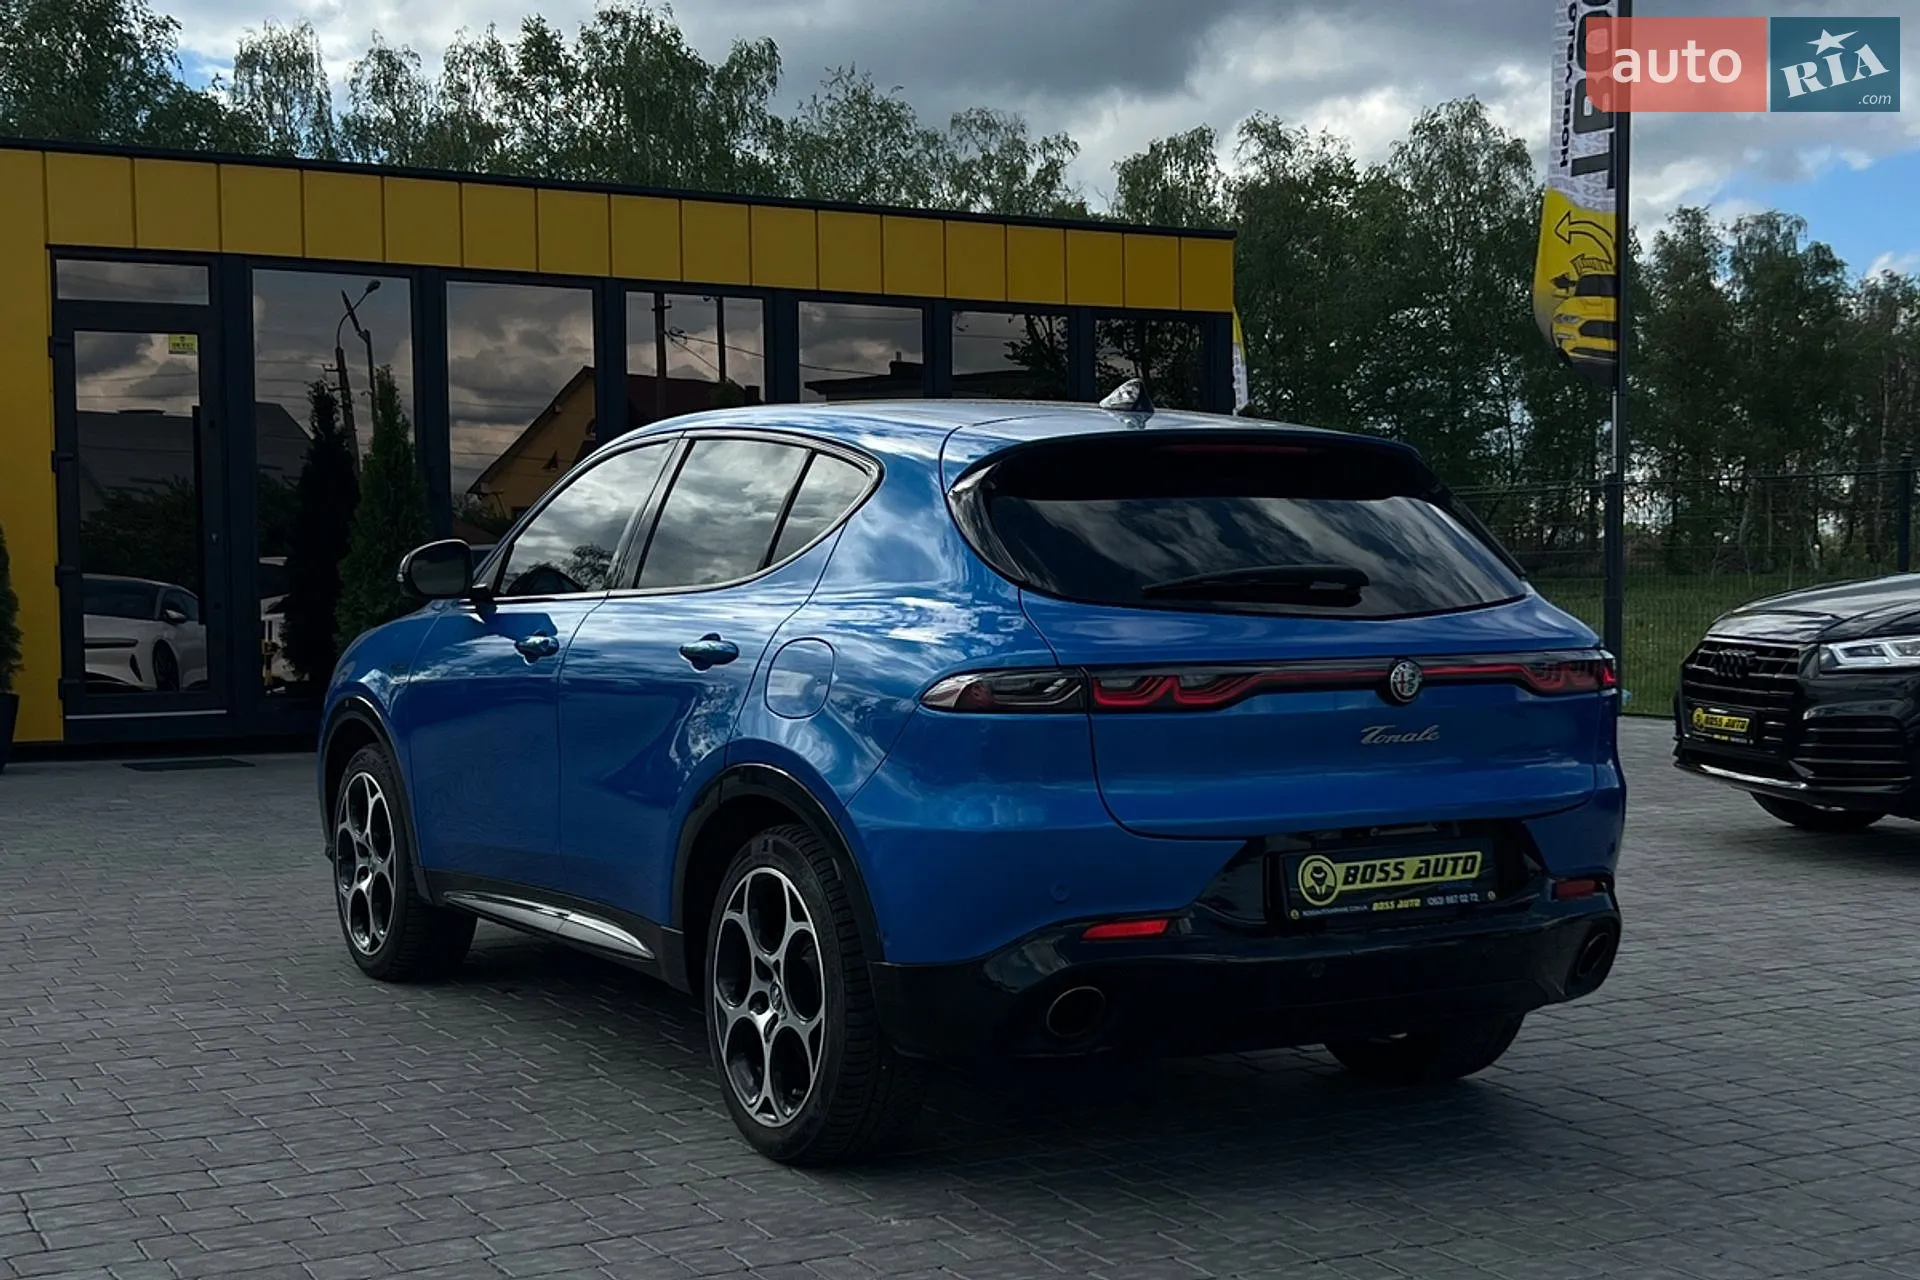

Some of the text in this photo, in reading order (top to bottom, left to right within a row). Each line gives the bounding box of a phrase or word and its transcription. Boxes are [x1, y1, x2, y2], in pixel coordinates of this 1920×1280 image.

[1361, 725, 1440, 744] Tonale
[1342, 855, 1478, 886] BOSS AUTO
[1372, 901, 1396, 911] BOSS
